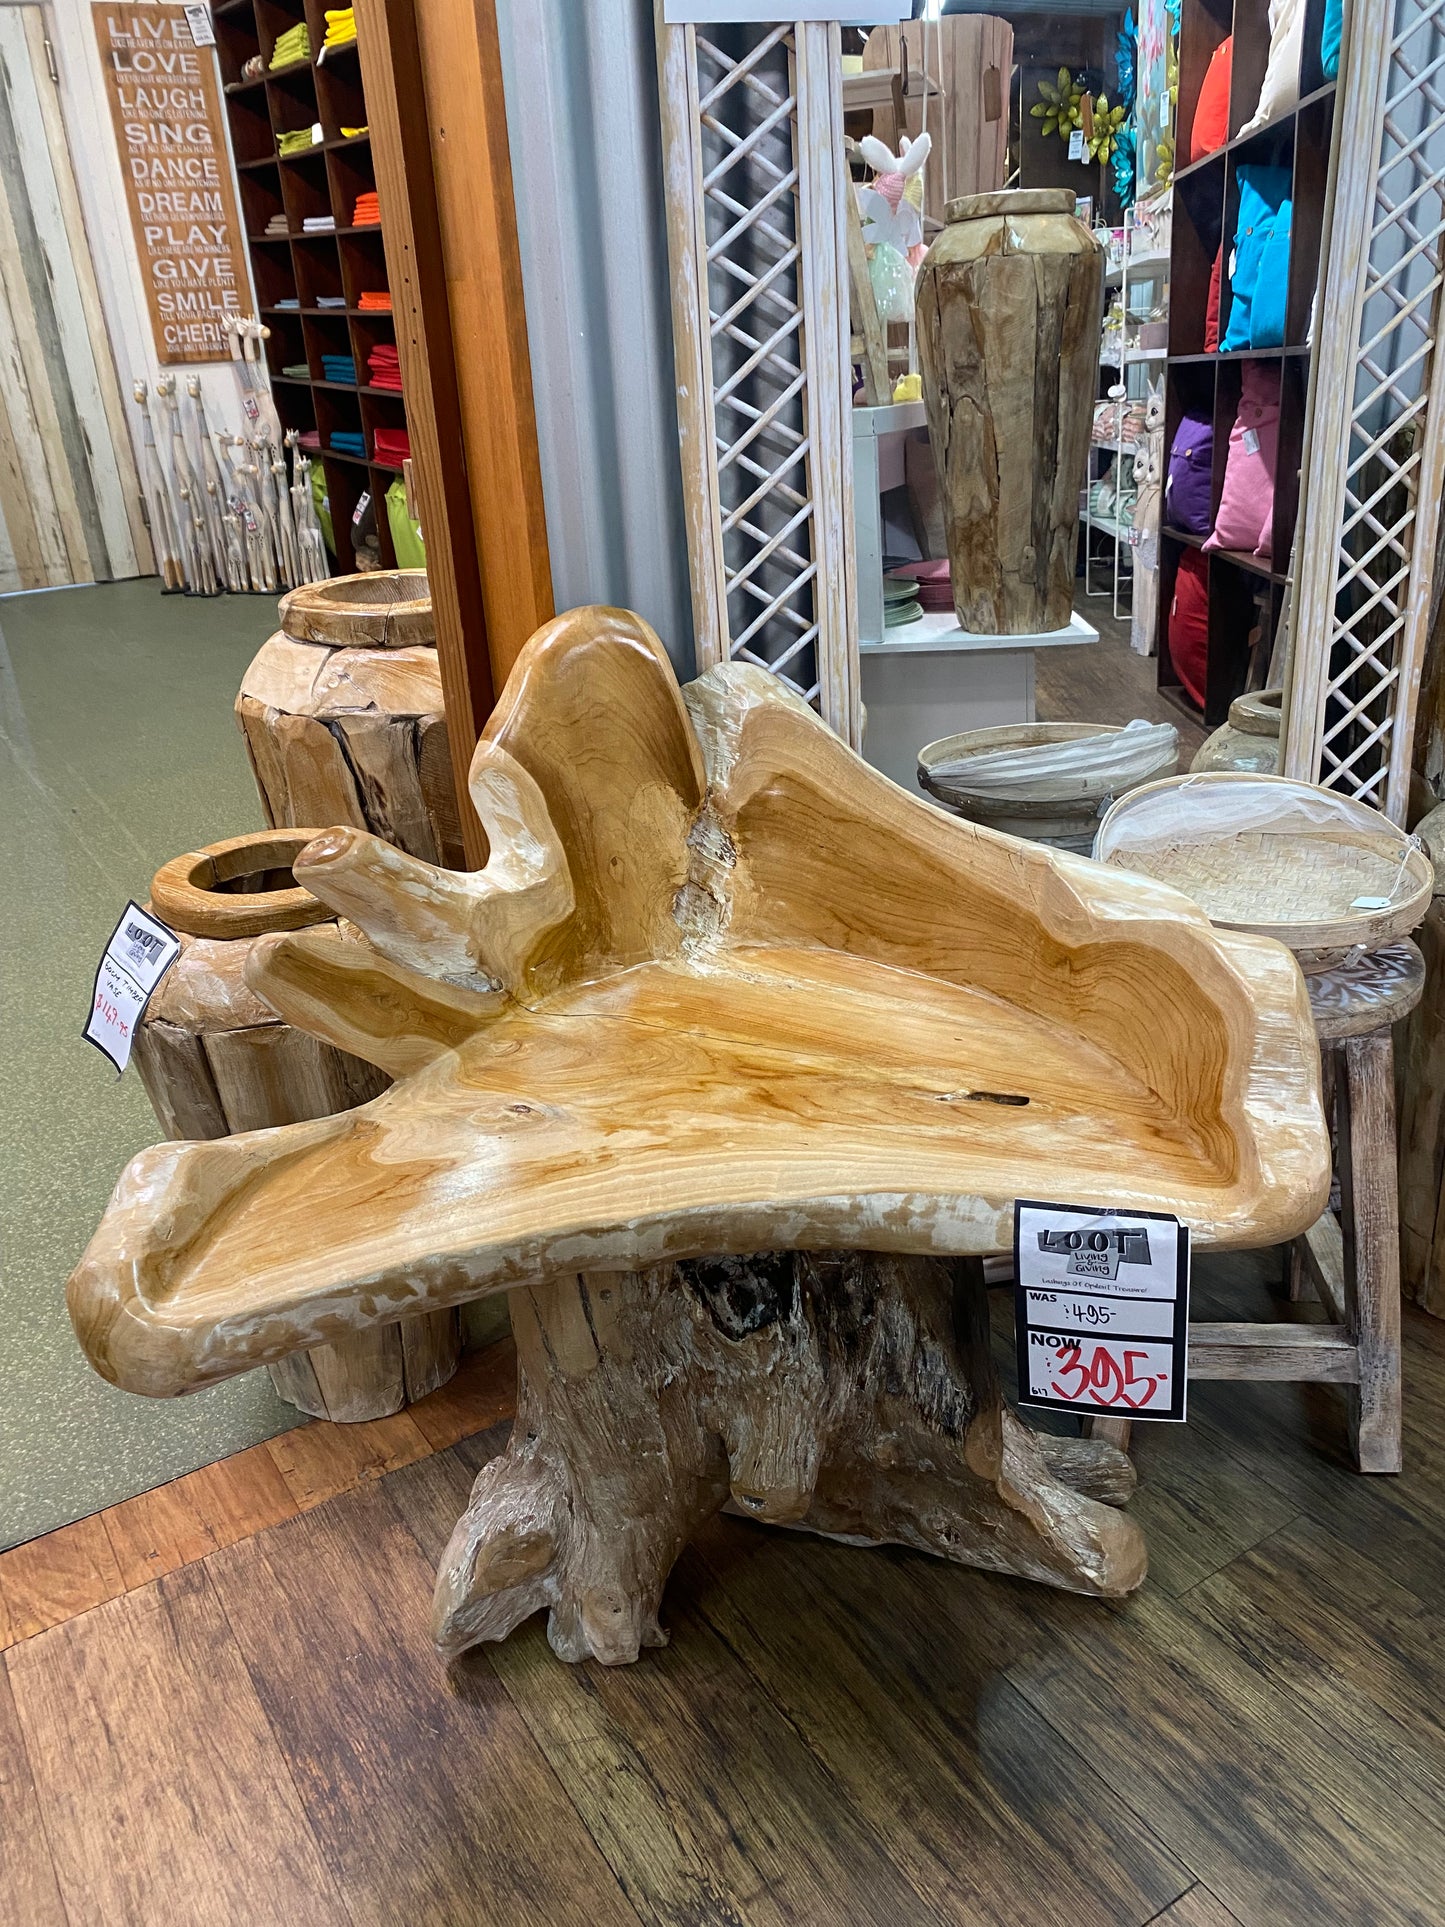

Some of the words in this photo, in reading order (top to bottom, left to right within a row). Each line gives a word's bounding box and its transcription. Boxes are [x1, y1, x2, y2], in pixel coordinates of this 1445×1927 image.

[107, 17, 194, 39] LIVE
[112, 51, 200, 73] LOVE
[117, 88, 206, 109] LAUGH
[122, 109, 138, 119] LIKE
[138, 109, 149, 119] NO
[150, 109, 164, 119] ONE
[165, 109, 172, 119] IS
[124, 122, 213, 144] SING
[147, 144, 159, 153] NO
[161, 144, 175, 153] ONE
[177, 144, 193, 153] CAN
[194, 144, 214, 153] HEAR
[130, 157, 219, 179] DANCE
[151, 178, 162, 187] NO
[163, 178, 177, 187] ONE
[137, 191, 223, 213] DREAM
[144, 224, 227, 246] PLAY
[147, 246, 162, 256] LIKE
[152, 257, 235, 279] GIVE
[153, 279, 170, 289] LIKE
[170, 278, 185, 288] YOU
[187, 277, 206, 287] HAVE
[207, 276, 235, 286] PLENTY
[157, 290, 240, 312] SMILE
[159, 311, 175, 321] TILL
[175, 311, 196, 320] YOUR
[197, 310, 215, 319] FACE
[163, 322, 229, 344] CHERIS
[127, 922, 164, 953] LOOT
[107, 981, 121, 998] VASE
[122, 979, 144, 1004] TIMBER
[1043, 1229, 1143, 1256] LOOT
[1075, 1252, 1108, 1263] Living
[1087, 1258, 1095, 1266] &
[1075, 1264, 1110, 1276] Giving
[1029, 1292, 1057, 1303] WAS
[1030, 1333, 1081, 1350] NOW
